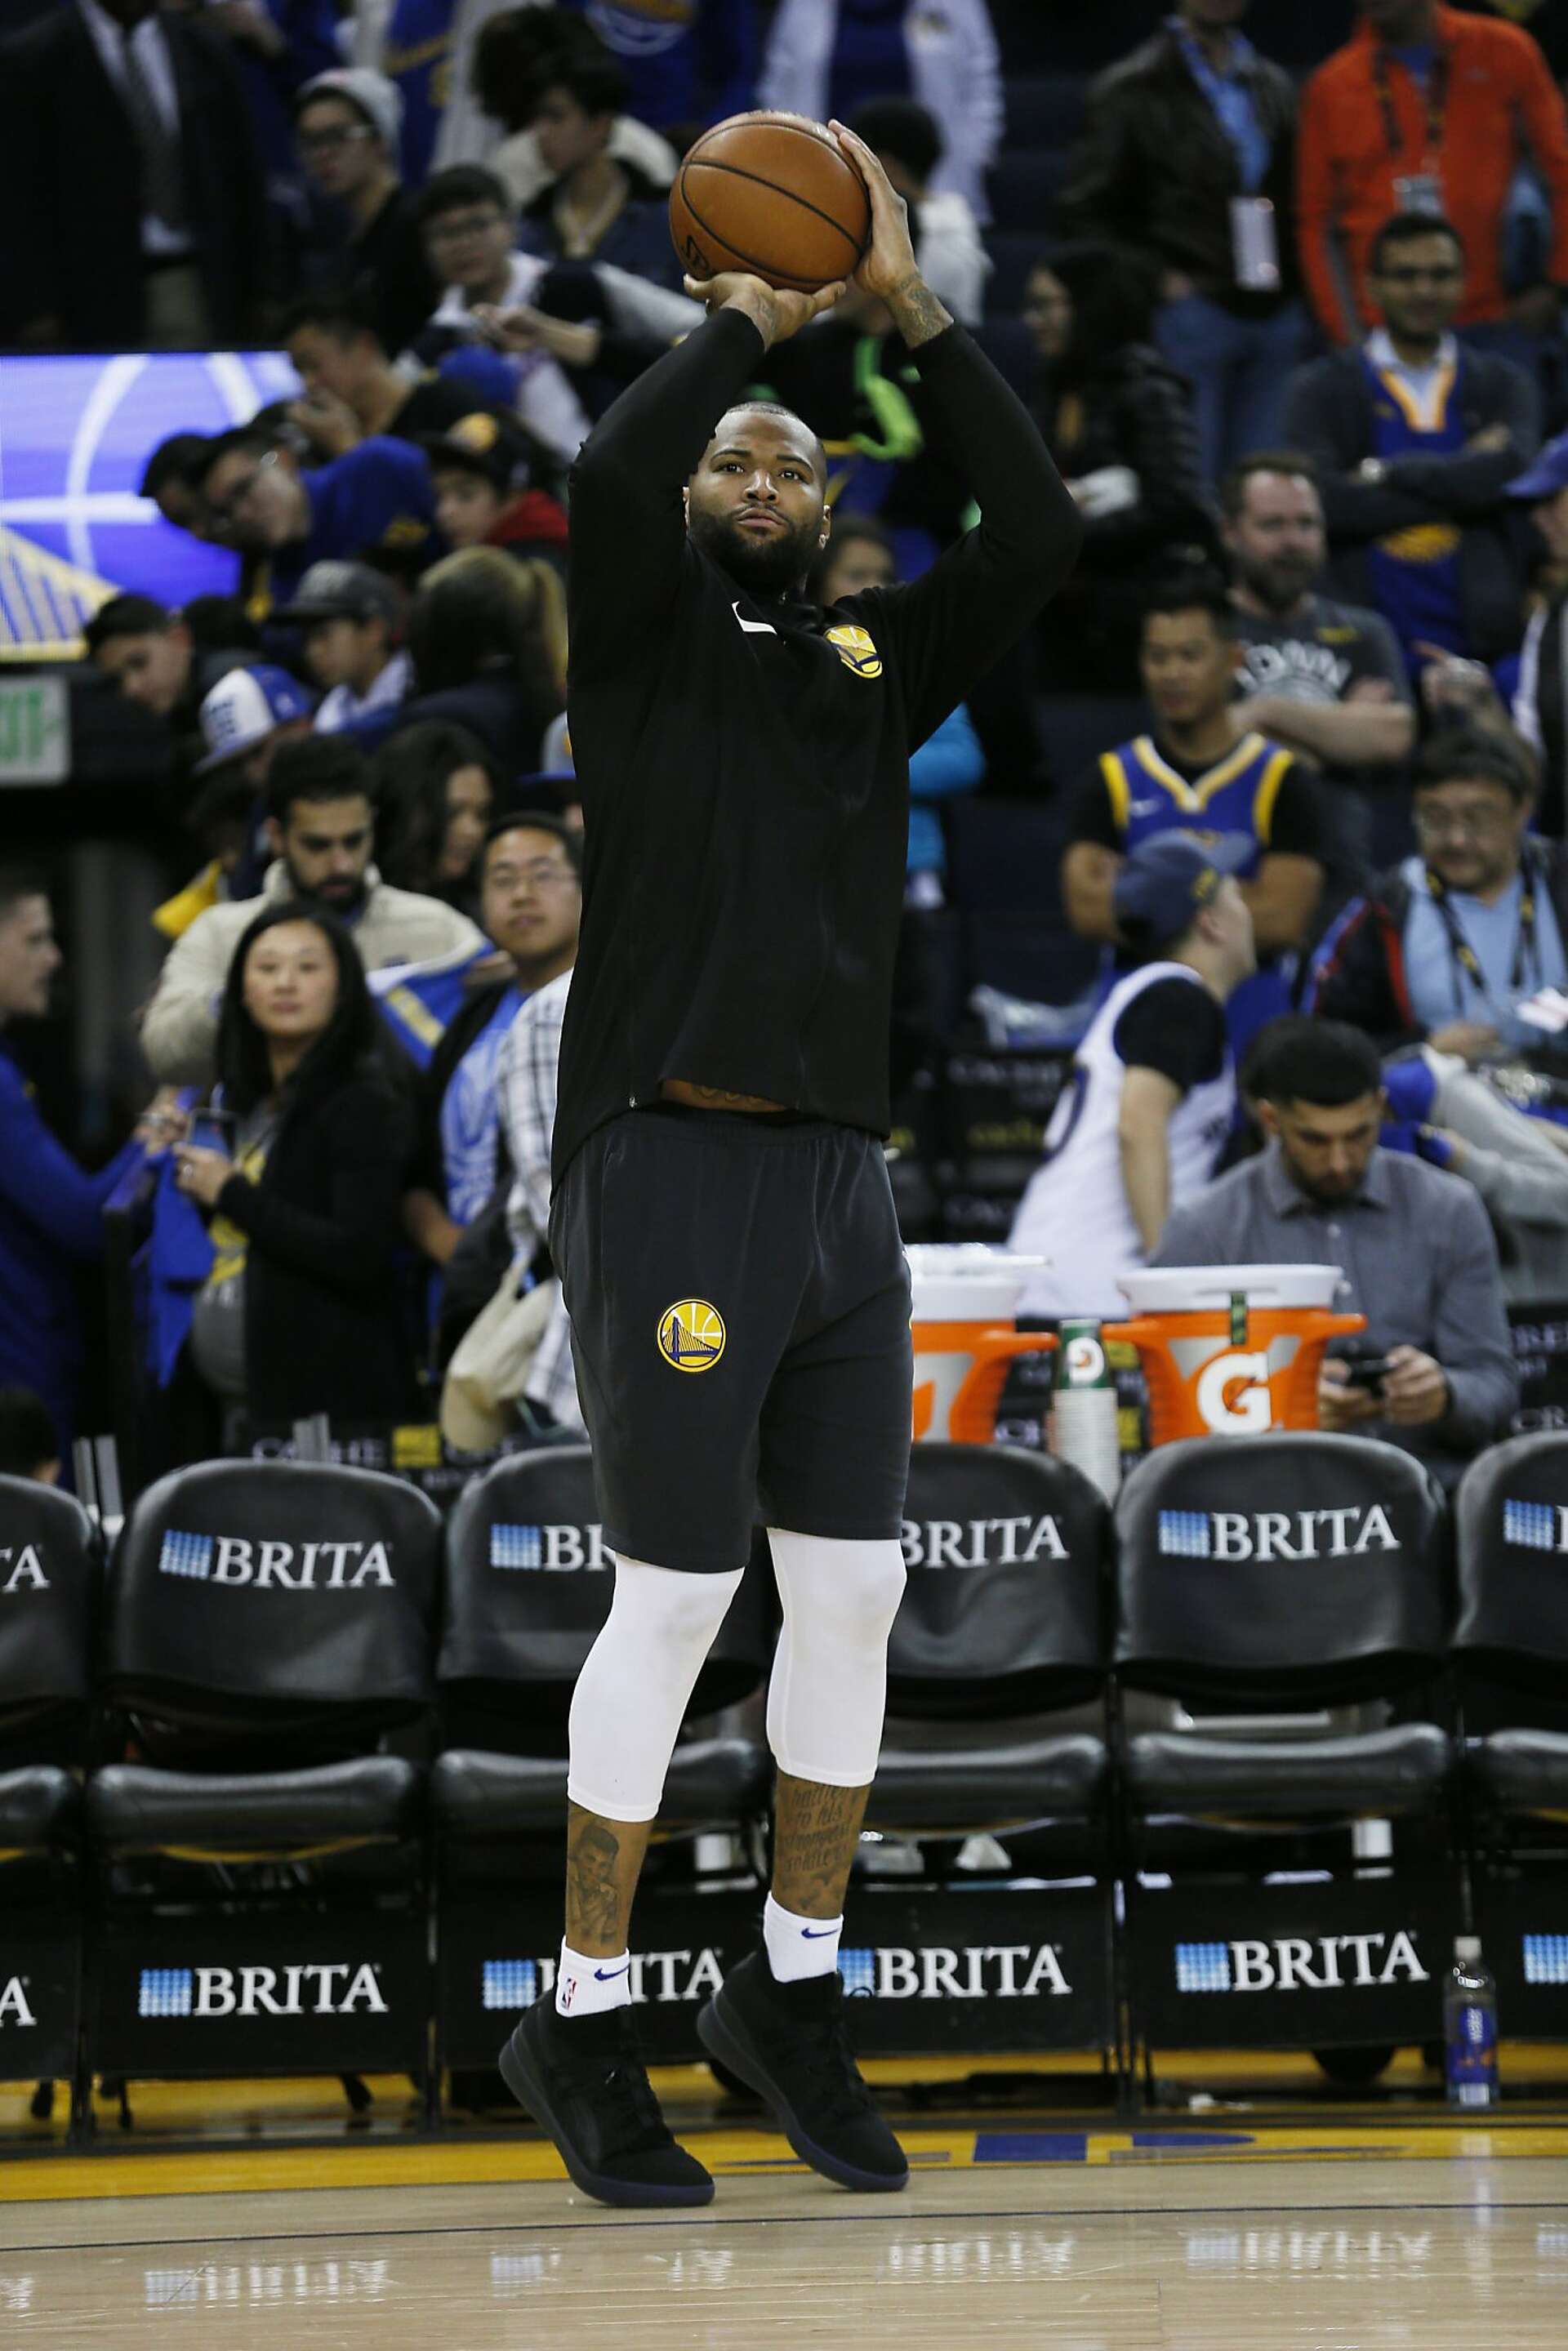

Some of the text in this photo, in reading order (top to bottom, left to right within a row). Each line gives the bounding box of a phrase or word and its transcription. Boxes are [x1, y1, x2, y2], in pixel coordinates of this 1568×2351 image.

[1197, 1351, 1272, 1435] G
[902, 1514, 1071, 1569] BRITA
[1211, 1503, 1402, 1562] BRITA
[211, 1536, 397, 1589] BRITA
[875, 1943, 1072, 1998] BRITA
[1228, 1930, 1430, 1992] BRITA
[193, 1963, 390, 2017] BRITA
